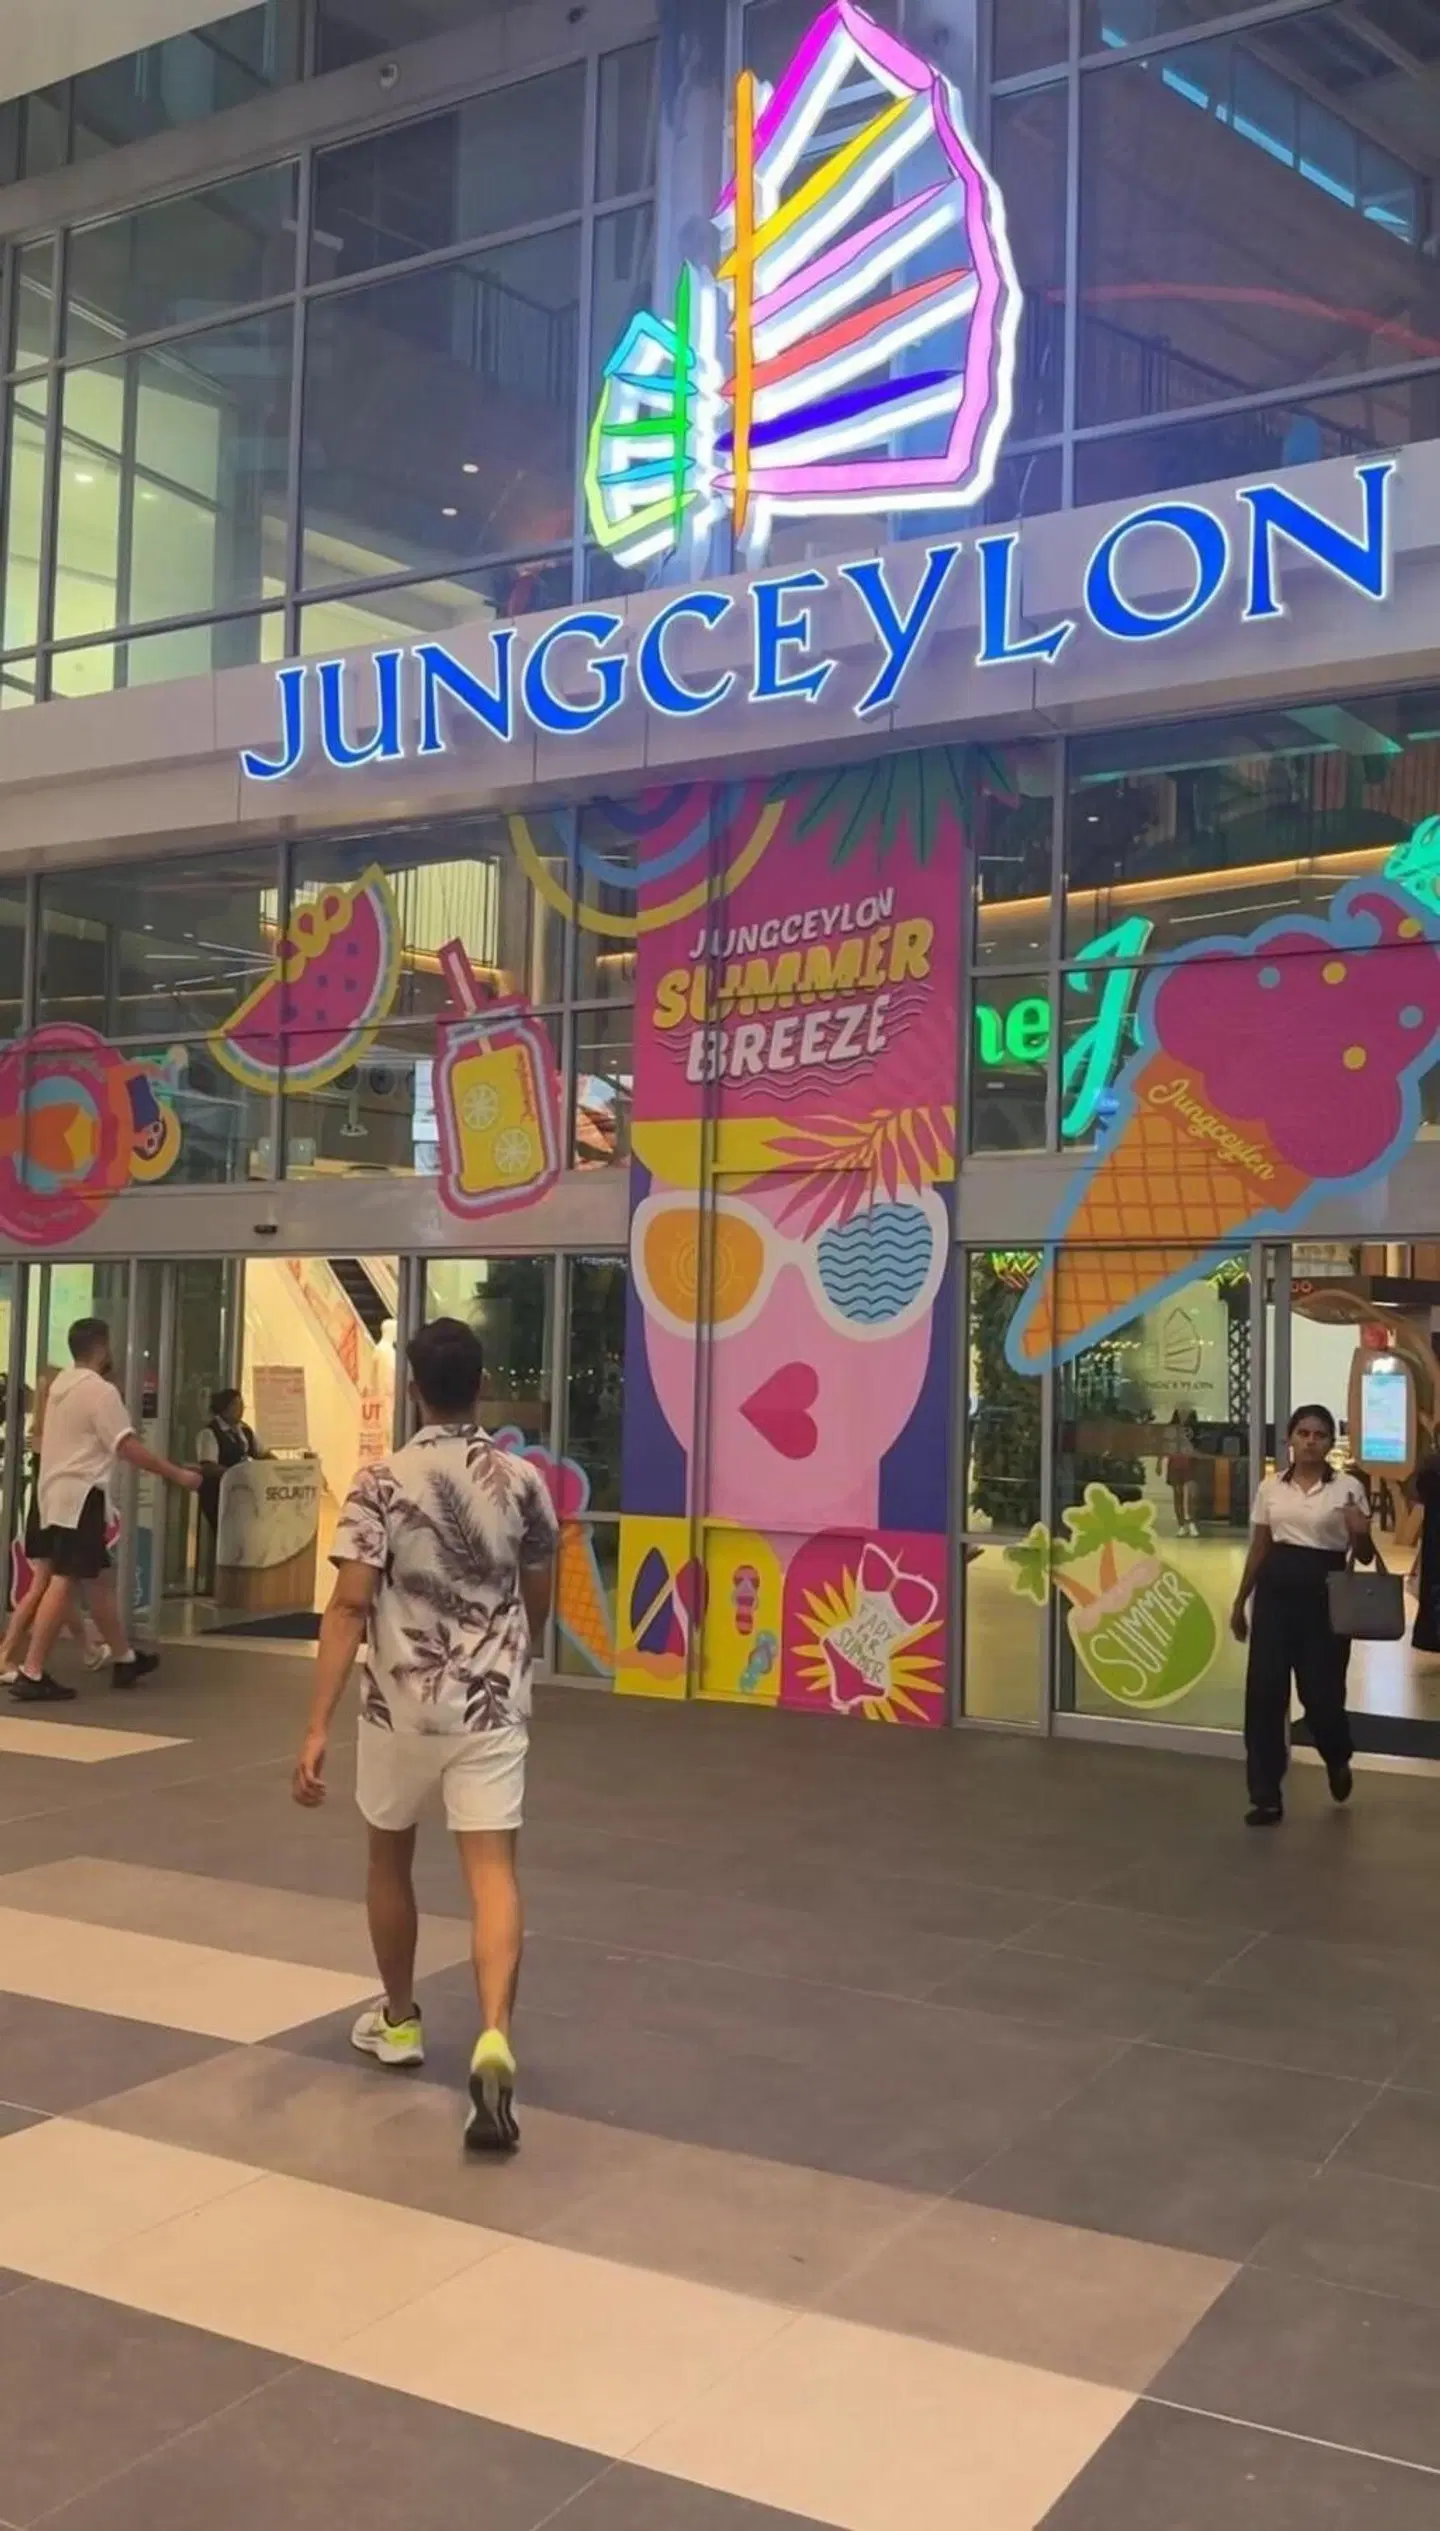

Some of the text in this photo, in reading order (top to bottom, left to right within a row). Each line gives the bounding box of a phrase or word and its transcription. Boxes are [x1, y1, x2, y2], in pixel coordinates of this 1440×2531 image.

[240, 460, 1397, 782] JUNGCEYLON
[653, 917, 935, 1030] SUMMER
[689, 887, 895, 959] JUNGCEYLON
[686, 994, 891, 1083] BREEZE
[266, 1485, 318, 1500] SECURITY
[1090, 1571, 1194, 1697] SUMMER
